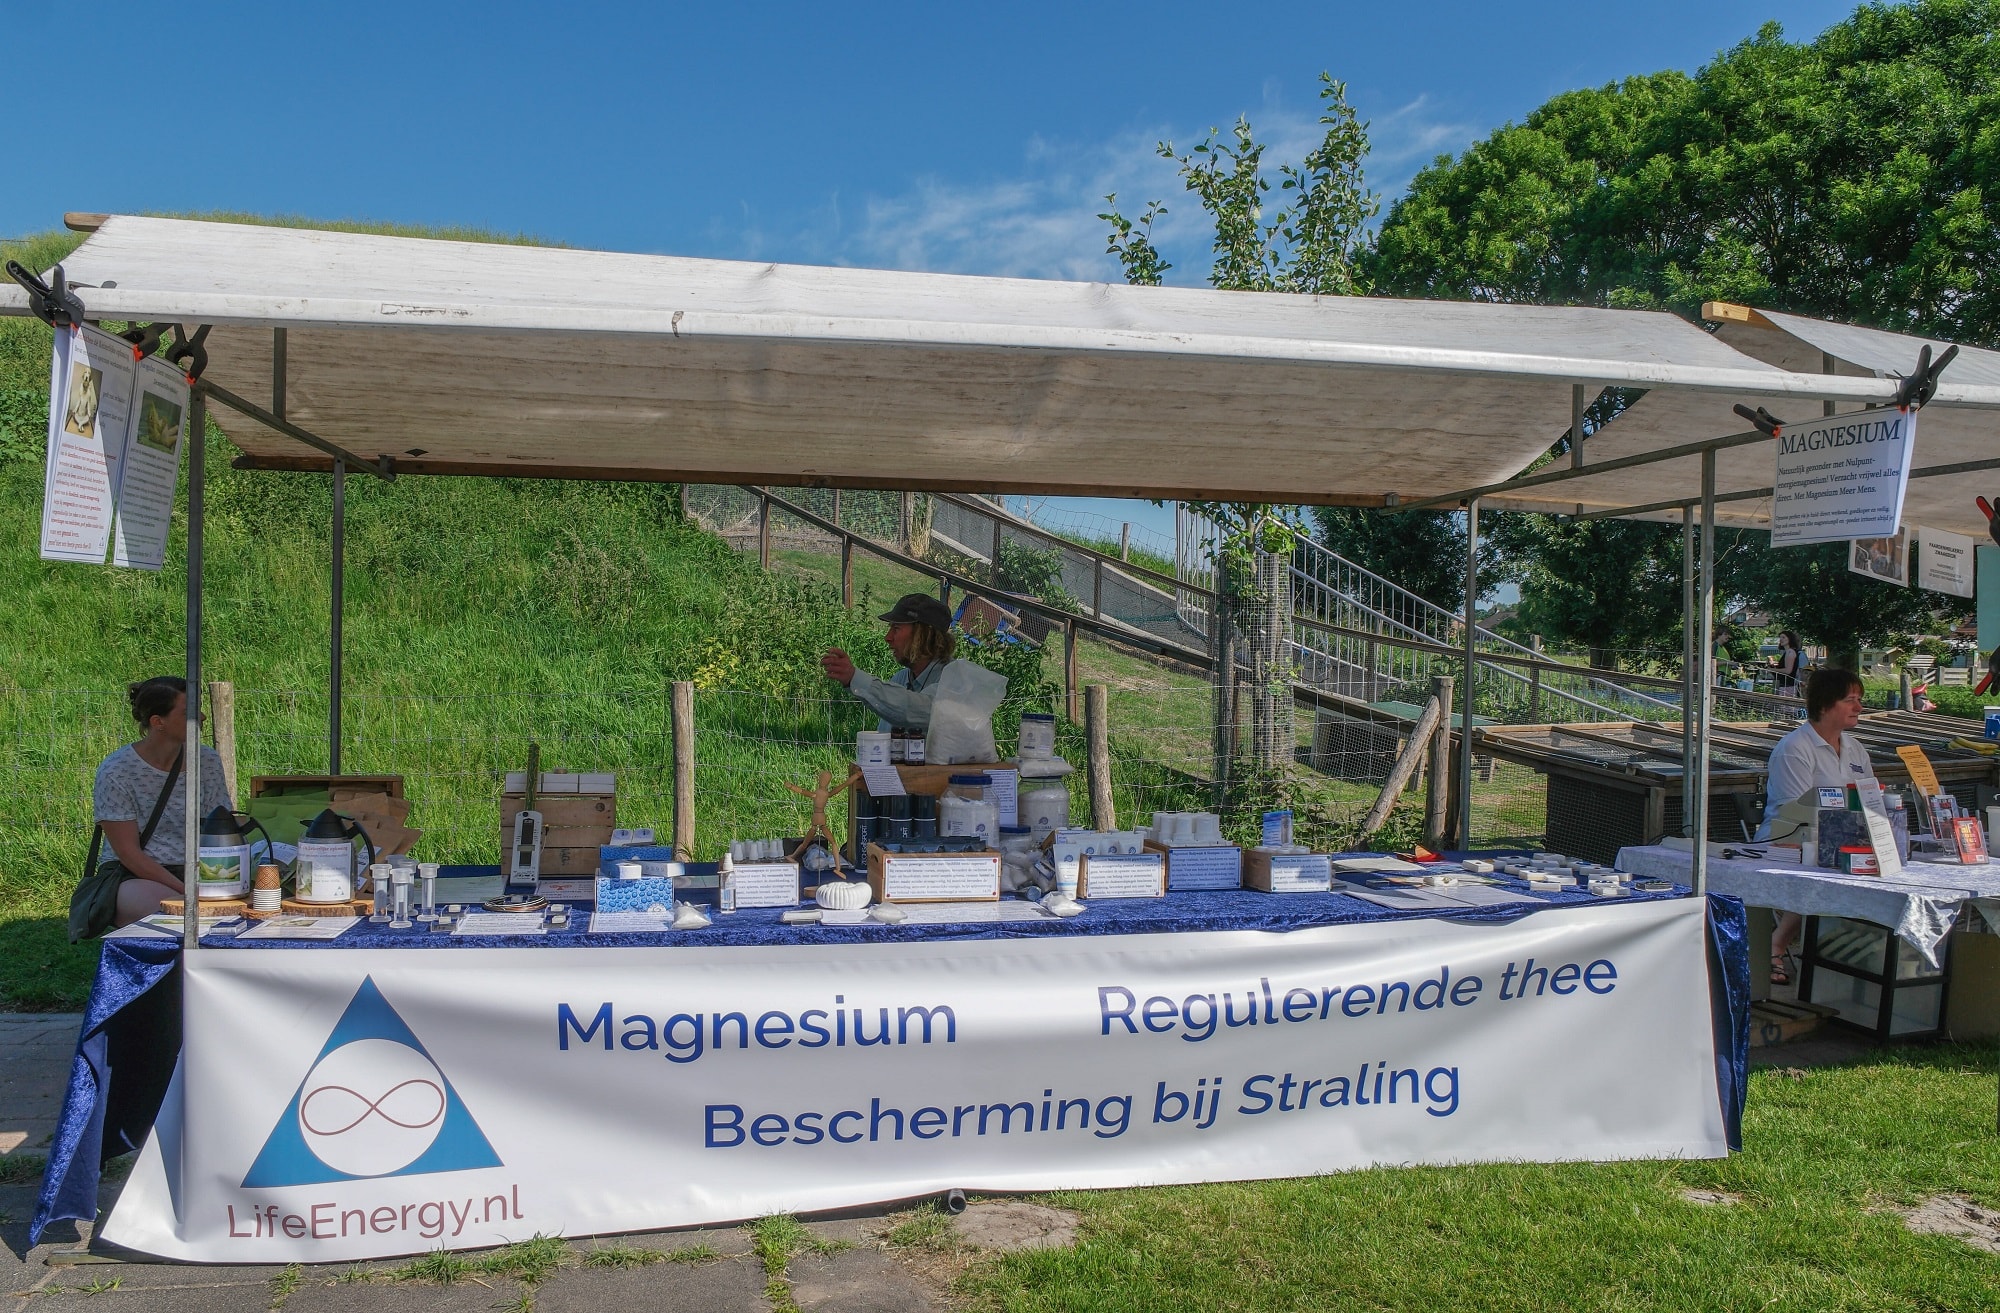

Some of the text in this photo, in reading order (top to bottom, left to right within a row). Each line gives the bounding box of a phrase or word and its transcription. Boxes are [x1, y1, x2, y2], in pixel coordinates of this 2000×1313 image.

[1780, 419, 1902, 455] MAGNESIUM
[1778, 457, 1876, 476] Natuurlijk gezonder met Nulpunt-
[1830, 472, 1857, 482] Verzacht
[1858, 469, 1882, 481] vrijwel
[1883, 468, 1899, 477] alles
[1794, 491, 1805, 500] Met
[1806, 489, 1838, 500] Magnesium
[1839, 486, 1856, 496] Meer
[1857, 485, 1877, 494] Mens.
[558, 957, 1618, 1064] Magnesium Regulerende thee
[704, 1060, 1461, 1149] Bescherming bij Straling
[227, 1183, 524, 1239] LifeEnergy.nl
